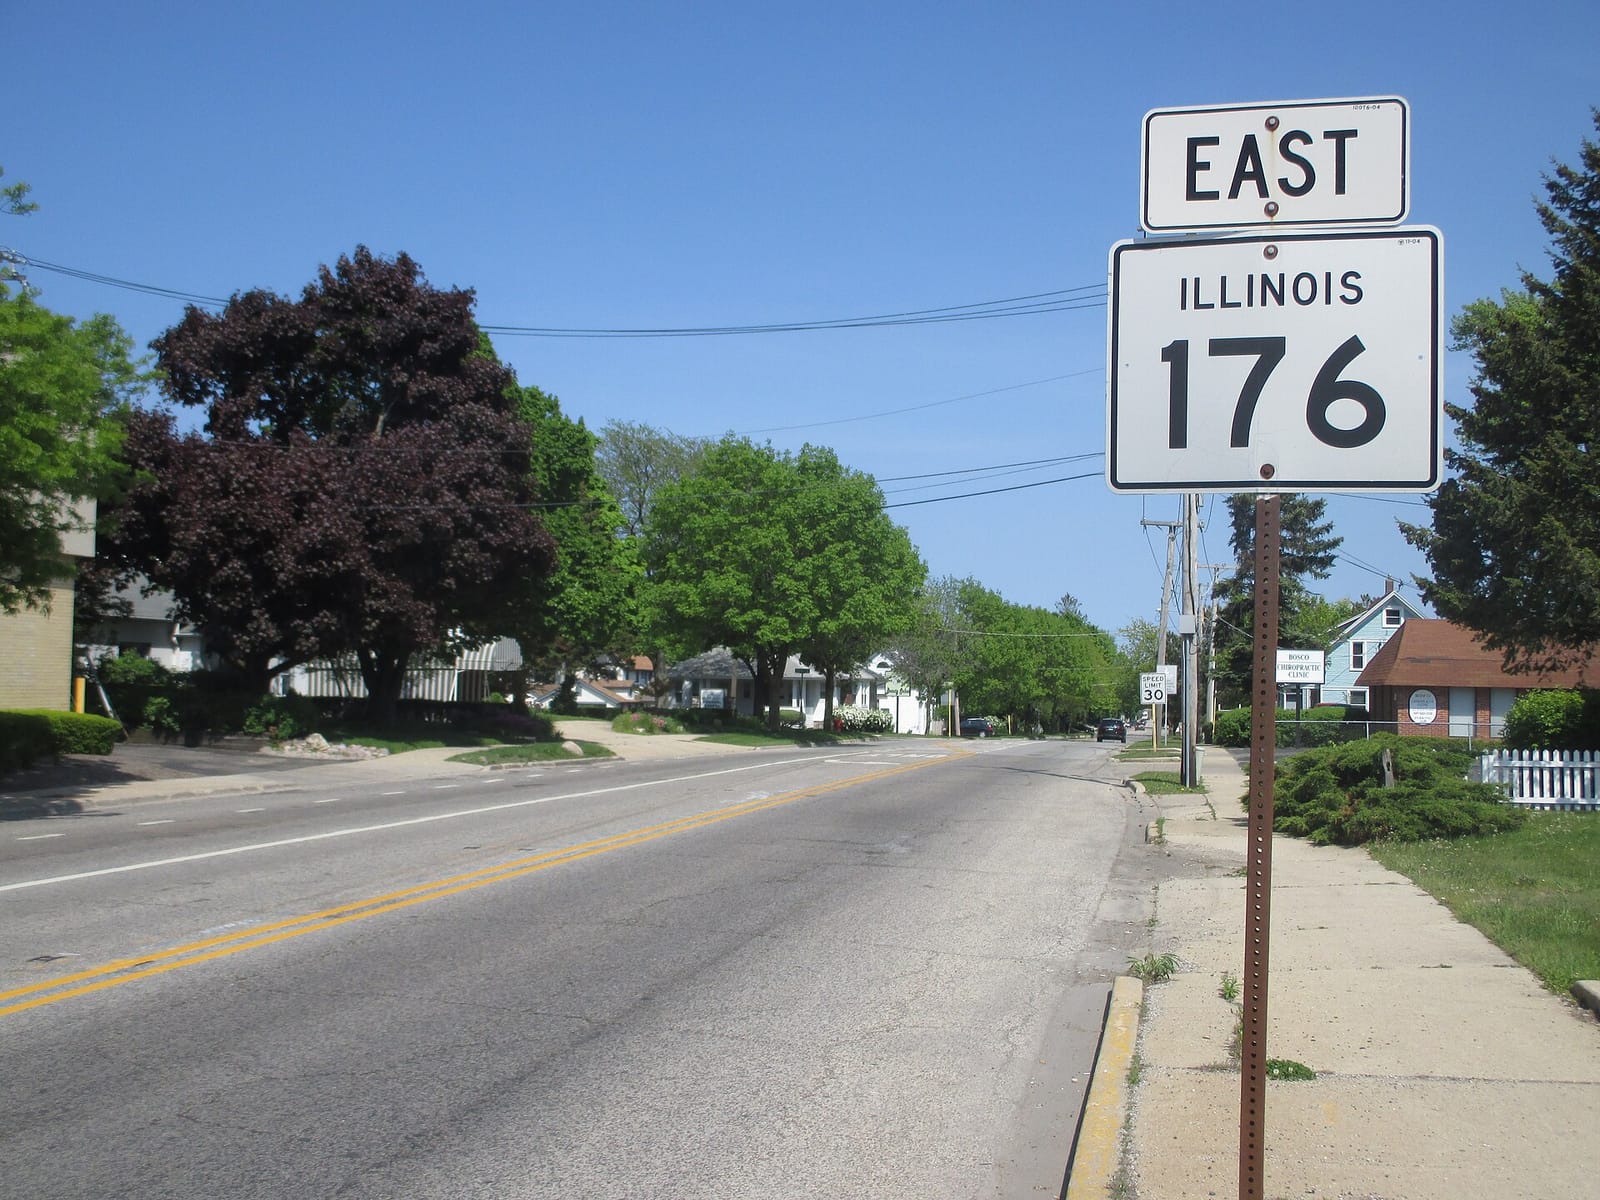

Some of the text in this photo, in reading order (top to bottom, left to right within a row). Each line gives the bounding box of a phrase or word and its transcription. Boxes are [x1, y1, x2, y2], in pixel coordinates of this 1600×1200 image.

[1186, 129, 1358, 201] EAST
[1180, 270, 1364, 310] ILLINOIS
[1161, 334, 1386, 449] 176
[1277, 663, 1322, 671] CHIROPRACTIC
[1287, 671, 1310, 679] CLINIC
[1143, 689, 1163, 701] 30
